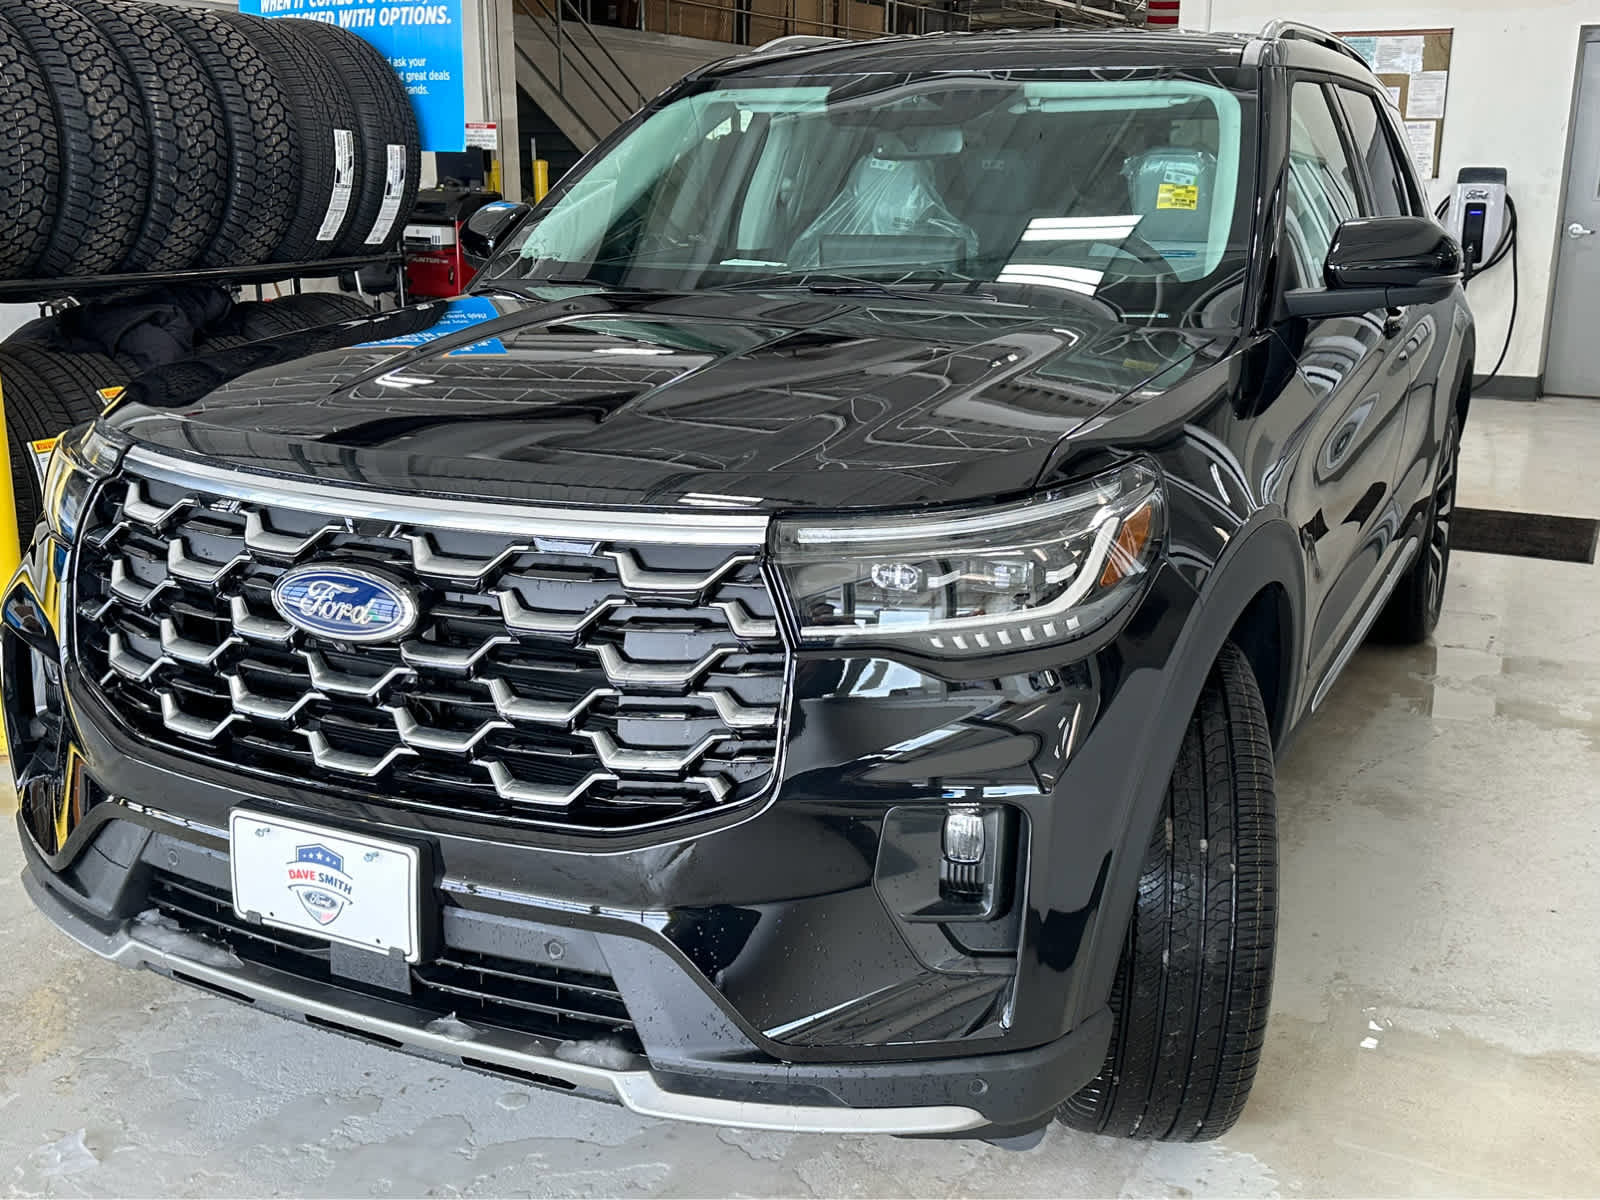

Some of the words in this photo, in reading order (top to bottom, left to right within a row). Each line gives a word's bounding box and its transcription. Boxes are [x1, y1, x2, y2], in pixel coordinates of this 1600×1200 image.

[339, 8, 376, 28] WITH
[379, 5, 452, 26] OPTIONS.
[393, 57, 407, 67] ask
[408, 58, 426, 69] your
[406, 71, 427, 83] great
[428, 70, 450, 81] deals
[300, 580, 376, 625] Ford
[288, 868, 316, 881] DAVE
[318, 872, 353, 895] SMITH
